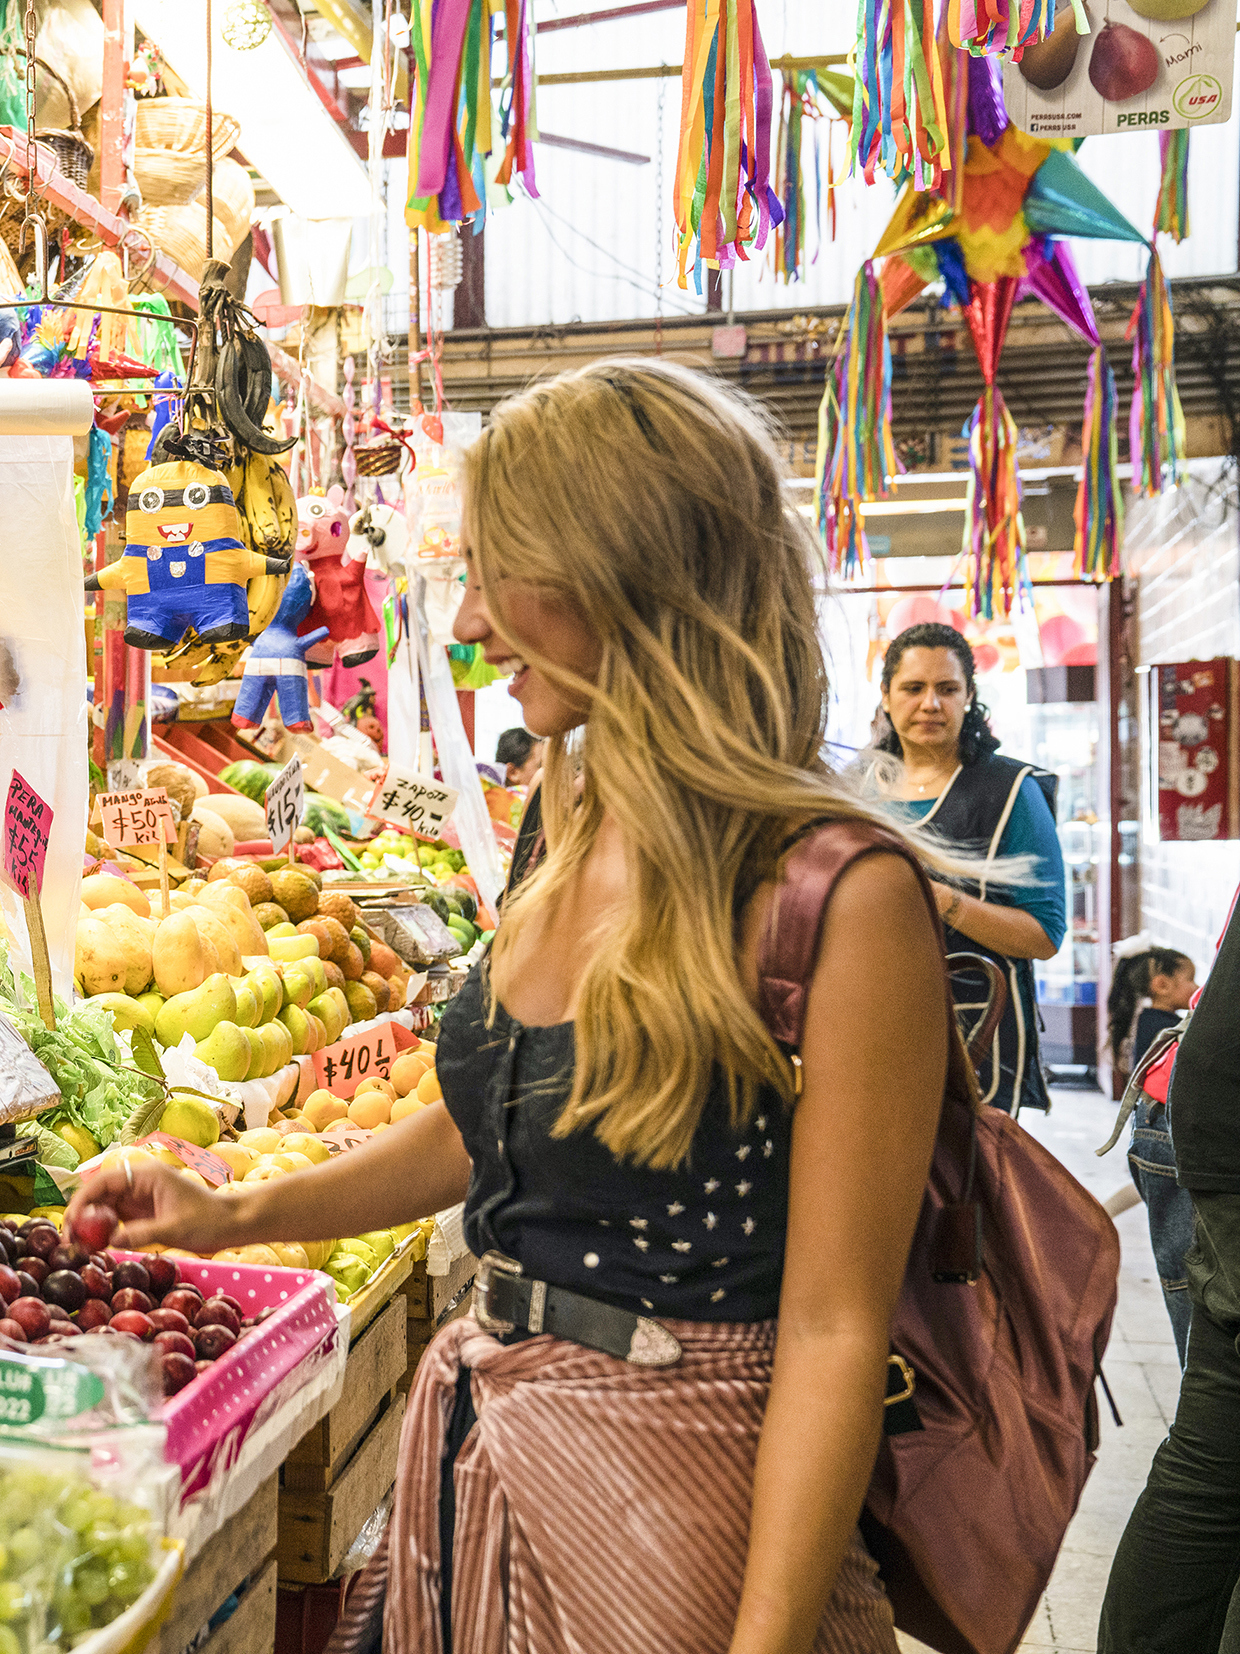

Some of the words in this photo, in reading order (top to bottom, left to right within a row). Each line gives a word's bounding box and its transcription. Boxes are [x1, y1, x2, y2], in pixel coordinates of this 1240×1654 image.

[1188, 94, 1218, 106] USA
[1116, 110, 1170, 128] PERAS
[10, 778, 44, 820] PERA
